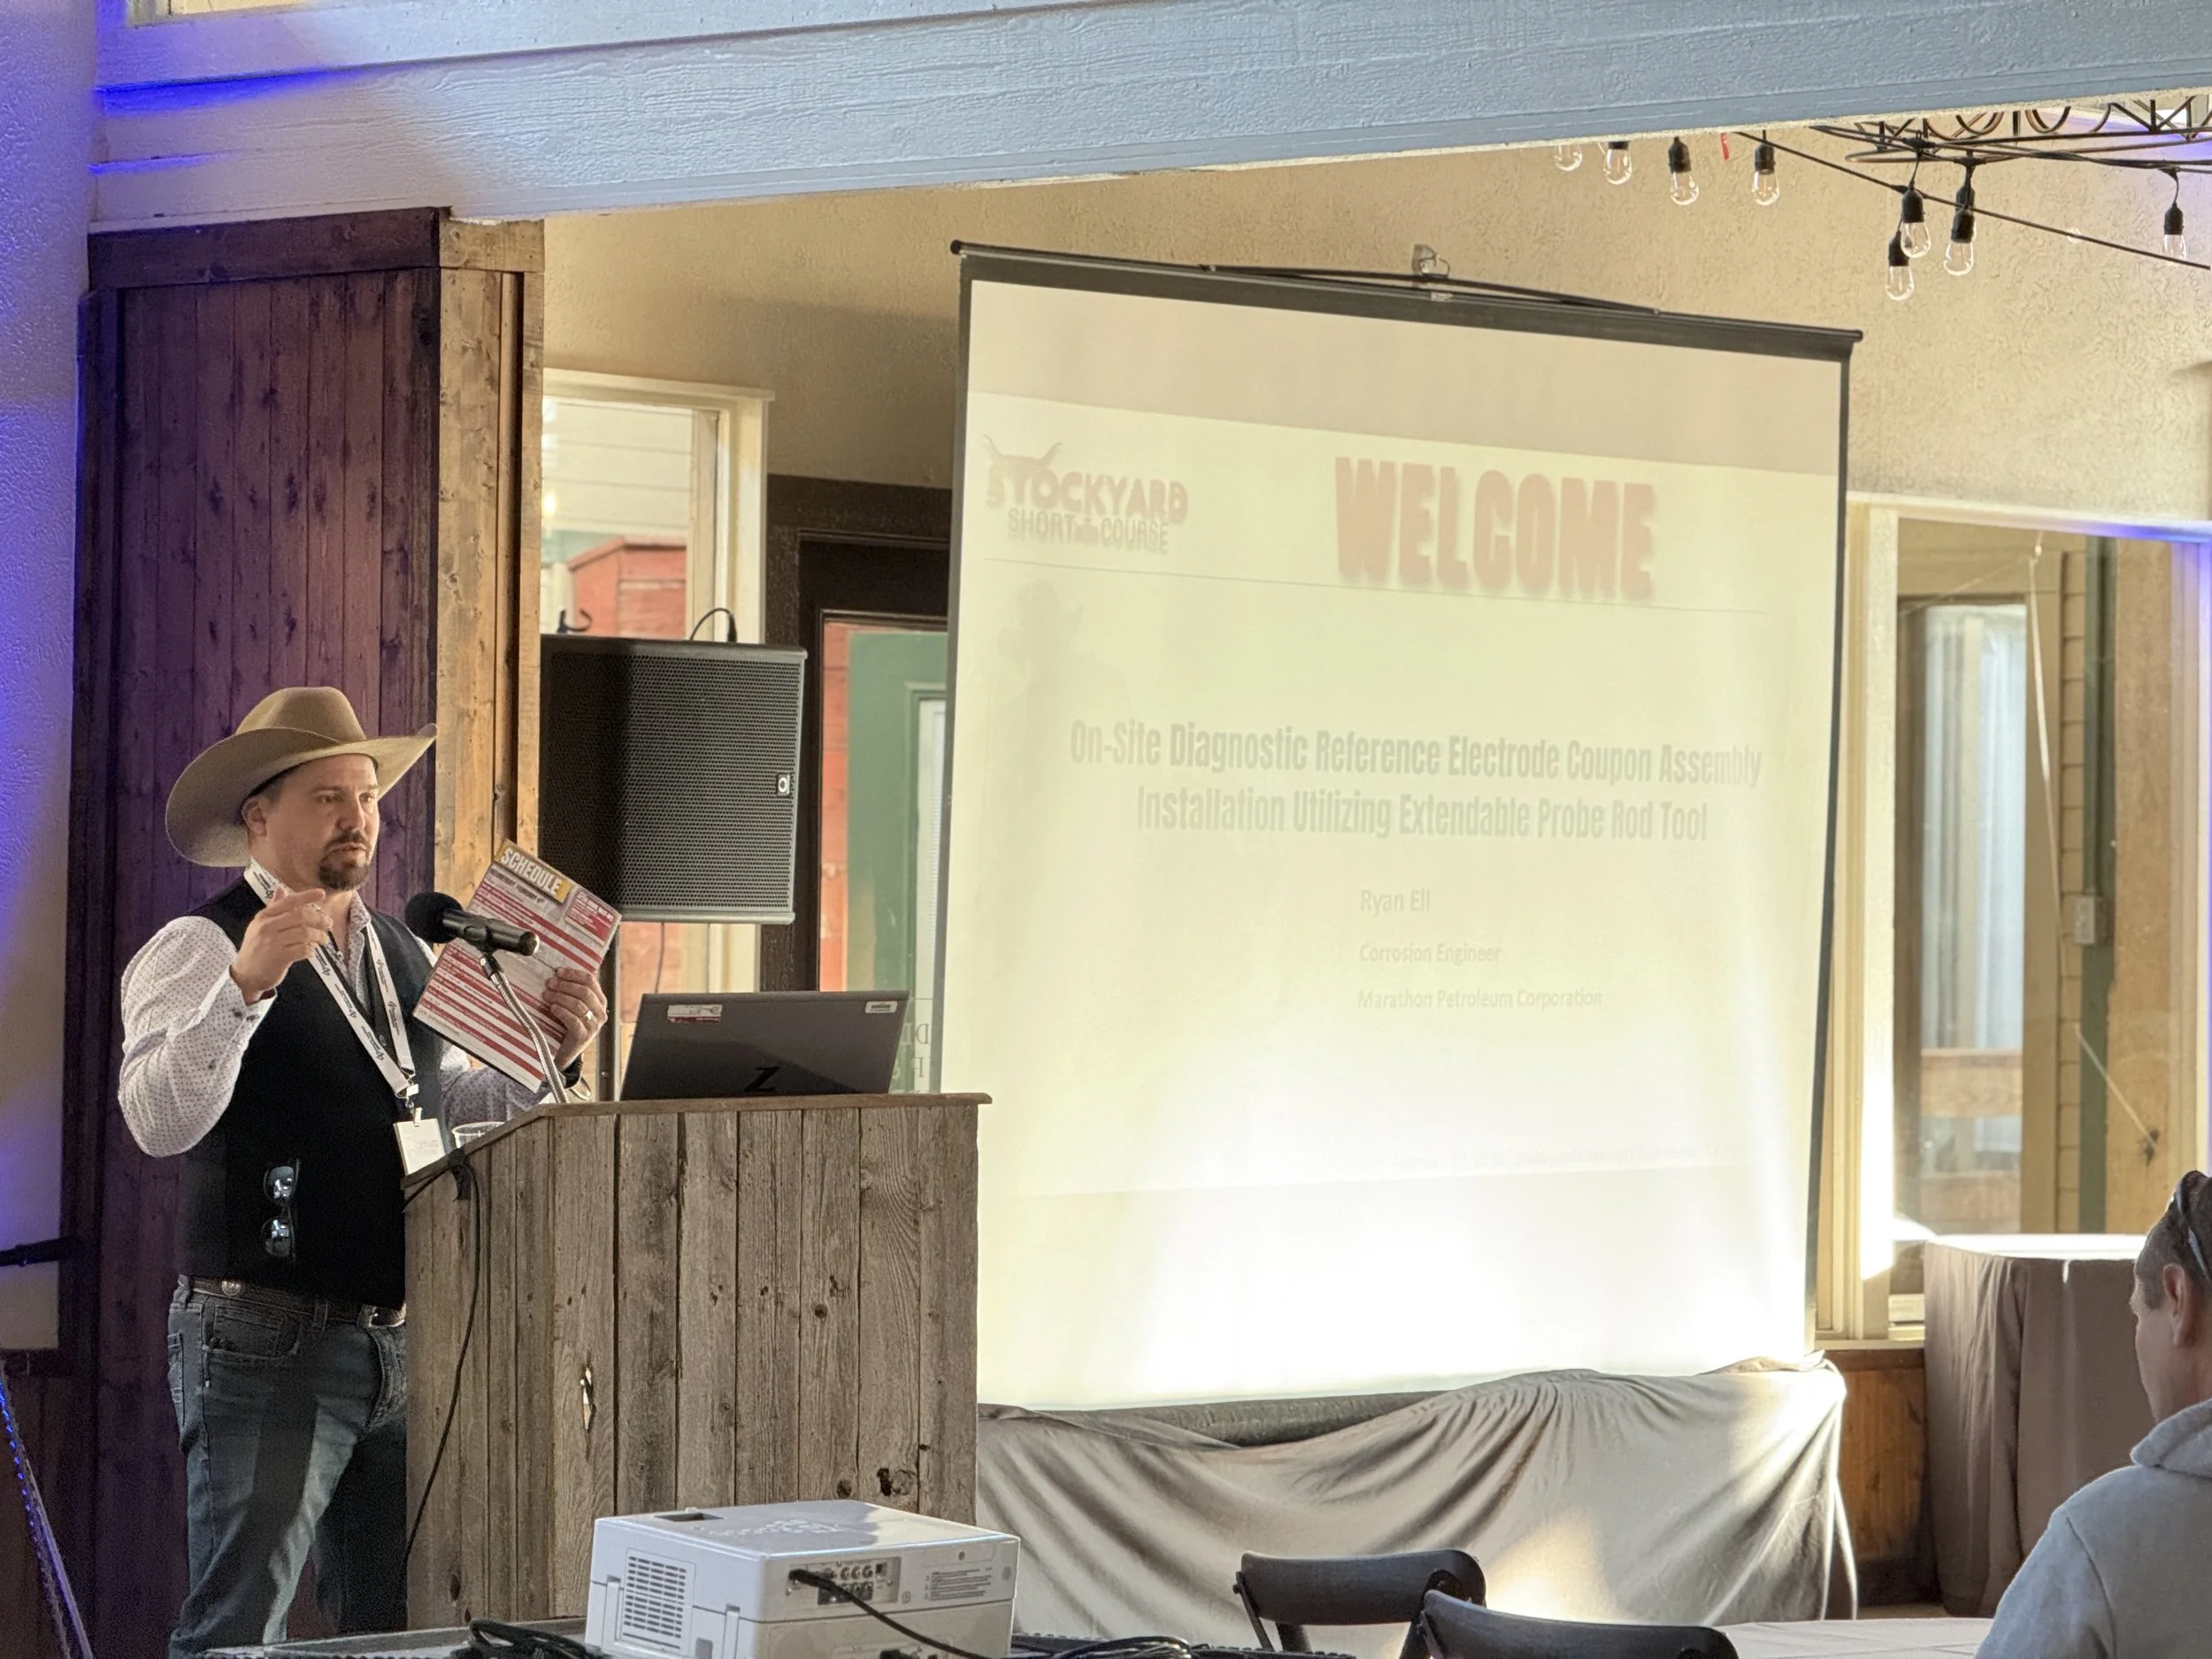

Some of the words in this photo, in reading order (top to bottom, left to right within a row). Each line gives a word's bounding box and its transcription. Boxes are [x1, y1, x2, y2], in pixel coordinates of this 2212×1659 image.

[984, 456, 1188, 525] STOCKYARD
[1007, 507, 1075, 544] SHORT
[1100, 518, 1170, 555] COURSE
[1335, 457, 1655, 602] WELCOME
[1070, 718, 1161, 765] On-Site
[1169, 721, 1309, 773] Diagnostic
[1315, 729, 1441, 776] Reference
[1448, 734, 1560, 779] Electrode
[1567, 740, 1653, 786] Coupon
[1658, 744, 1763, 789] Assembly
[1136, 785, 1286, 833] Installation
[1292, 787, 1393, 840] Utilizing
[1399, 794, 1531, 838] Extendable
[1537, 797, 1606, 839] Probe
[1610, 799, 1654, 840] Rod
[1660, 801, 1708, 841] Tool
[500, 846, 562, 897] SCHEDULE
[1360, 889, 1405, 917] Ryan
[1410, 888, 1431, 912] Ell
[1359, 942, 1432, 964] Corrosion
[1436, 942, 1502, 966] Engineer
[1358, 988, 1432, 1009] Marathon
[1437, 987, 1514, 1009] Petroleum
[1517, 987, 1603, 1010] Corporation
